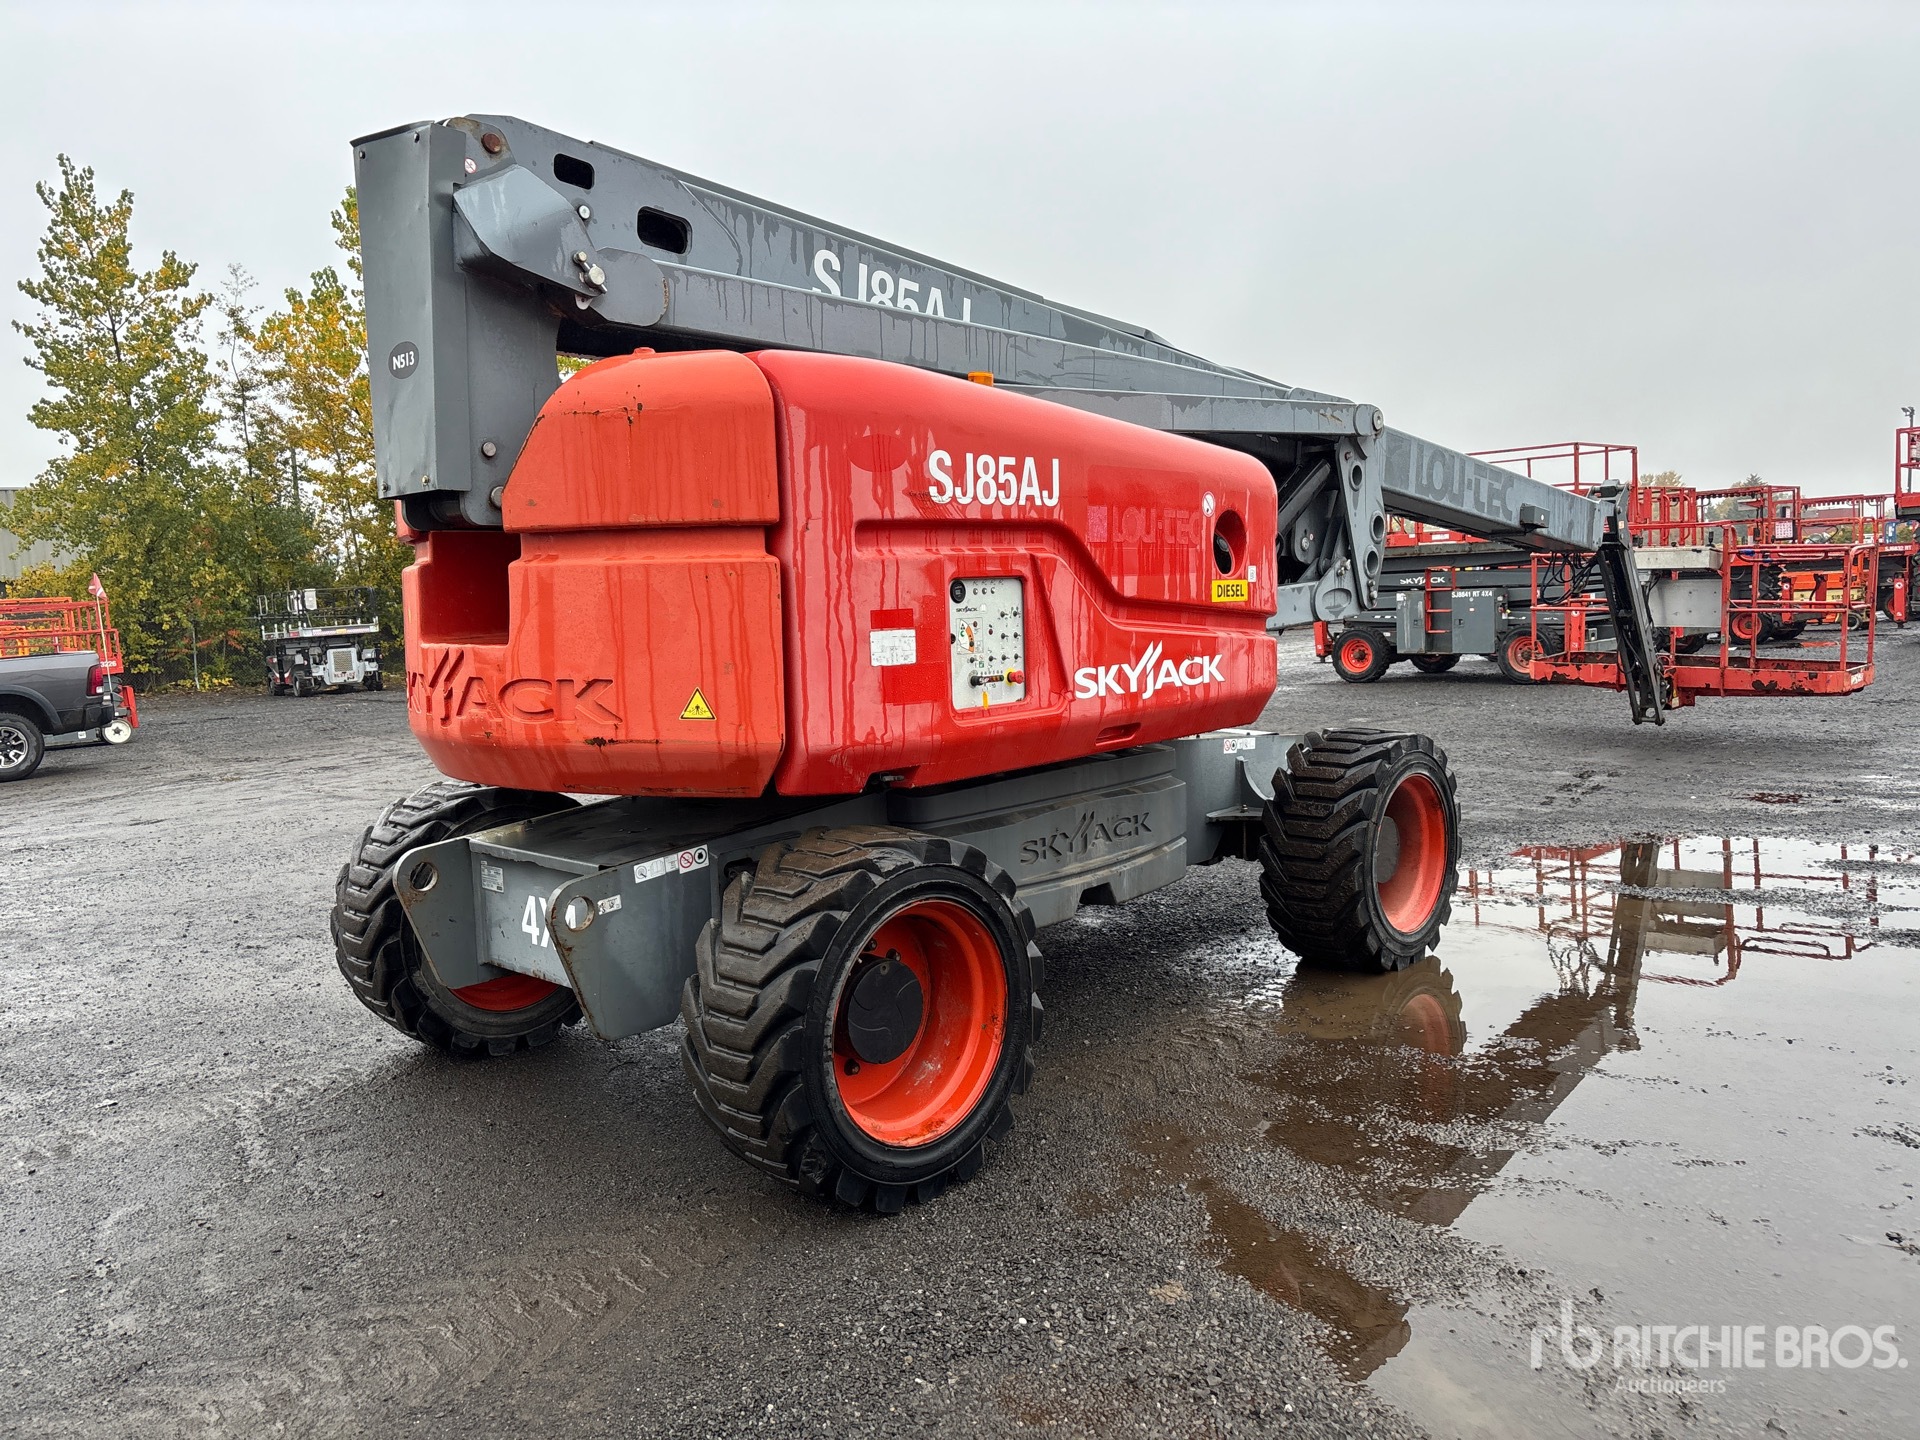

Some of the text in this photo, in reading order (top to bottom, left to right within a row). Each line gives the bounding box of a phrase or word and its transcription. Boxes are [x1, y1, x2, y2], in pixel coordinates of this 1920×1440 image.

[392, 350, 415, 371] N513
[928, 449, 1060, 507] SJ85AJ
[1216, 584, 1245, 598] DIESEL
[1400, 576, 1445, 585] SKYJCK
[956, 605, 978, 613] SKYJACK
[406, 647, 624, 730] KYJACK
[1074, 640, 1225, 700] SKYJACK
[1020, 811, 1152, 865] SKYJACK
